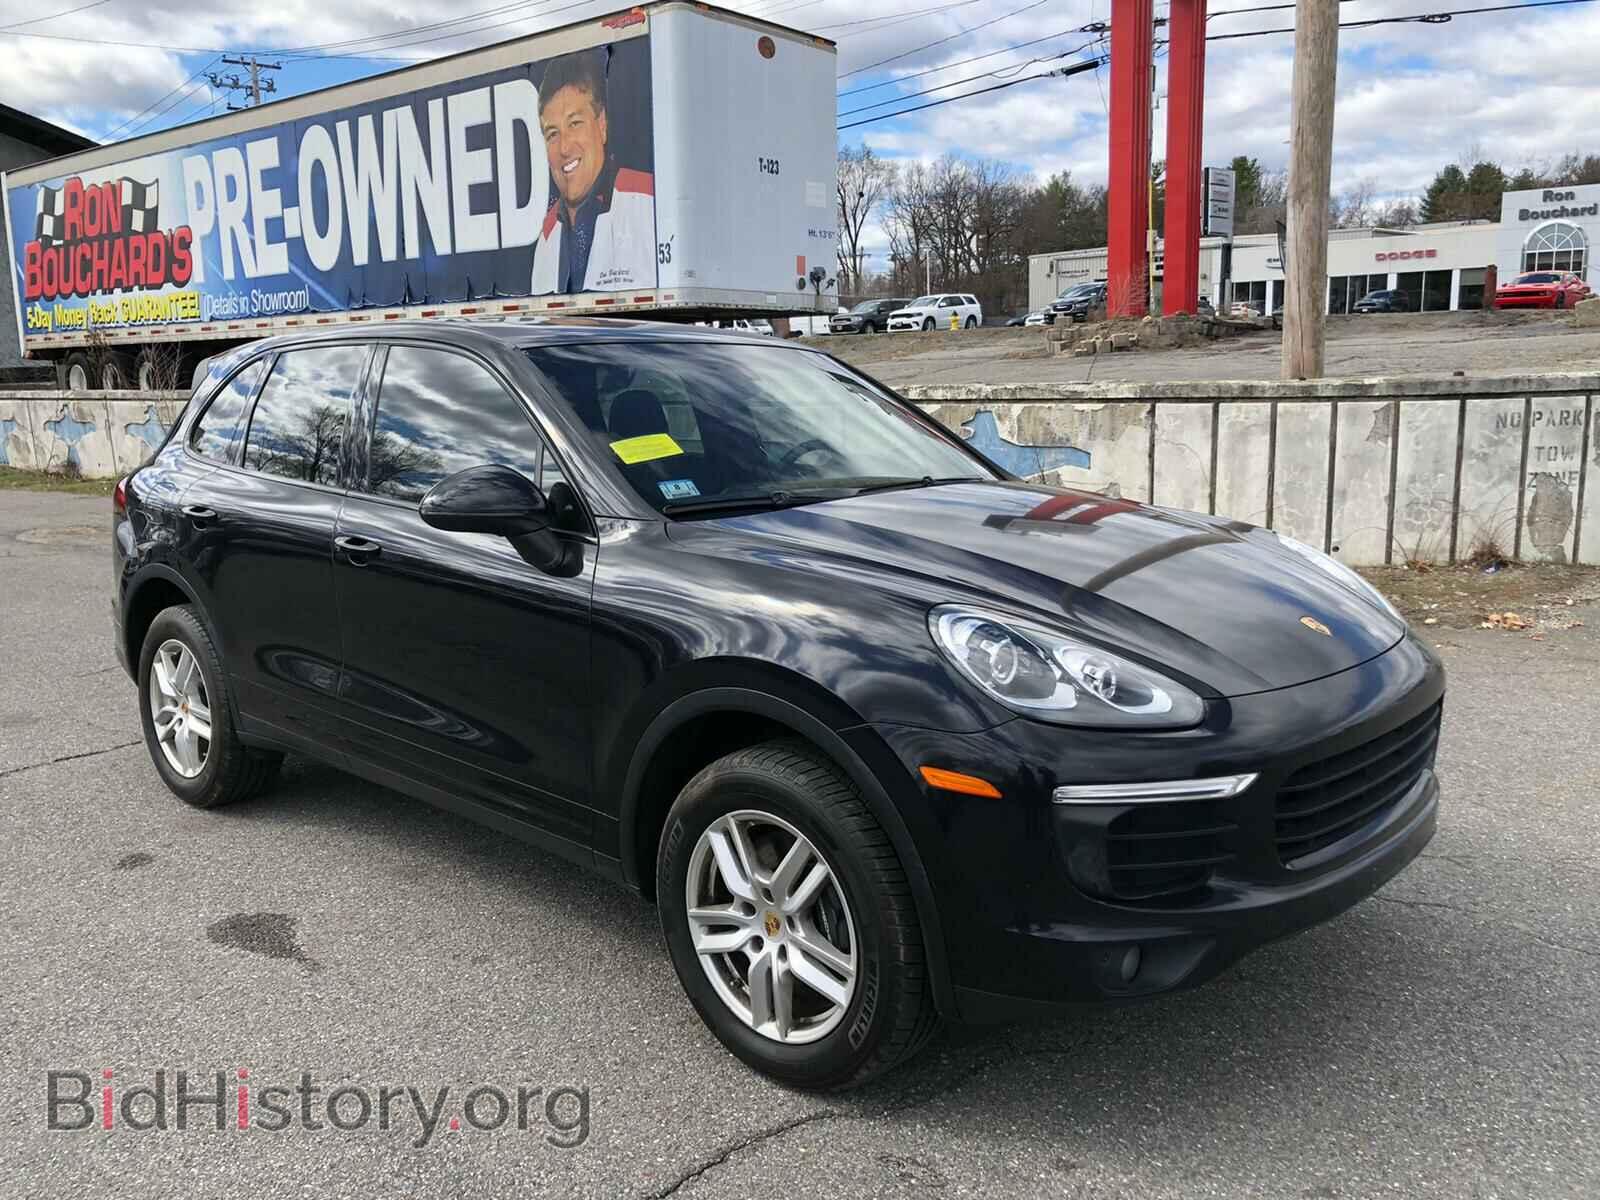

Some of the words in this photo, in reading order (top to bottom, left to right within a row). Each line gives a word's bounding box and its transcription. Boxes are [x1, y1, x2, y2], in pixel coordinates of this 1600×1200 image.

[759, 157, 780, 175] T-123
[182, 79, 550, 283] PRE-OWNED
[1542, 190, 1576, 202] Ron
[64, 177, 122, 241] RON
[1518, 203, 1598, 221] Bouchard
[24, 226, 193, 299] BOUCHARD'S
[1375, 249, 1437, 262] DODGE
[26, 307, 53, 331] 5-Day
[54, 304, 88, 329] Money
[89, 302, 118, 325] Back
[121, 291, 199, 324] GUARANTEE!
[239, 291, 249, 313] in
[1496, 411, 1522, 428] NO
[1532, 410, 1584, 427] PARK
[1535, 446, 1576, 461] TOW
[1527, 471, 1579, 488] ZNE
